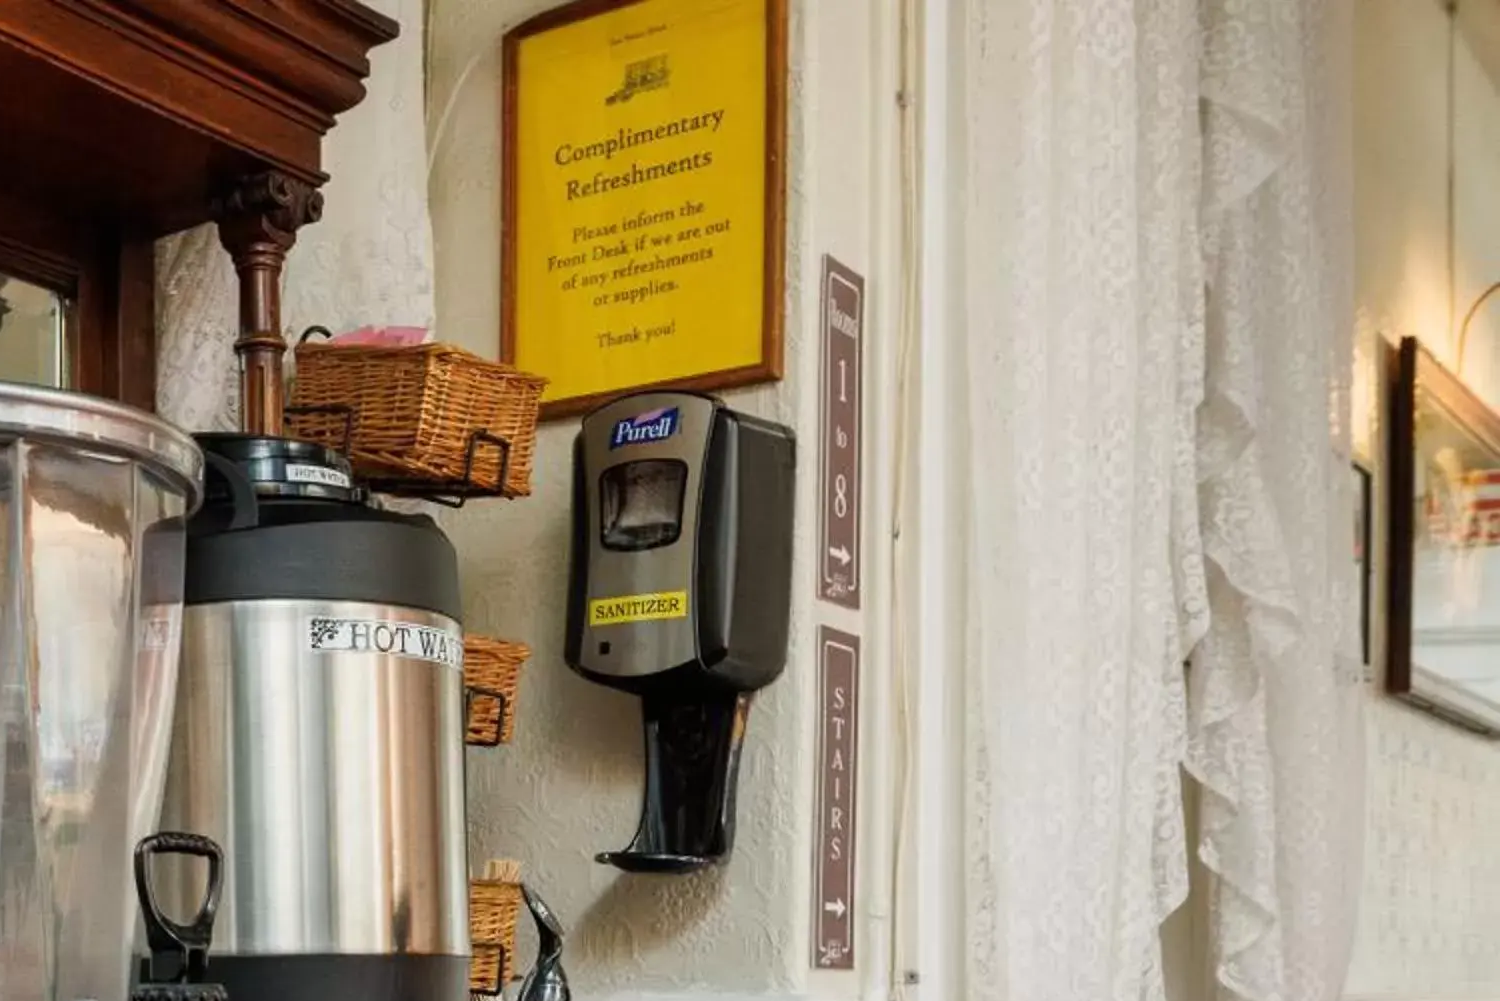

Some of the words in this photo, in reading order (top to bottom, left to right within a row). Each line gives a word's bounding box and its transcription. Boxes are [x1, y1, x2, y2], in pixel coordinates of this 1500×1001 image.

[555, 109, 724, 166] Complimentary
[566, 150, 713, 201] Refreshments
[573, 223, 618, 244] Please
[622, 208, 676, 232] inform
[679, 200, 705, 218] the
[547, 253, 588, 273] Front
[592, 239, 629, 262] Desk
[634, 234, 647, 252] if
[651, 233, 673, 247] we
[676, 226, 701, 242] are
[705, 218, 731, 236] out
[561, 272, 579, 291] of
[581, 270, 608, 289] any
[612, 246, 714, 281] refreshments
[593, 292, 609, 308] or
[613, 278, 680, 305] supplies.
[596, 326, 640, 349] Thank
[615, 417, 672, 444] Purell
[834, 473, 847, 519] 8
[595, 597, 680, 619] SANITIZER
[351, 623, 410, 653] HOT
[830, 687, 845, 861] STAIRS
